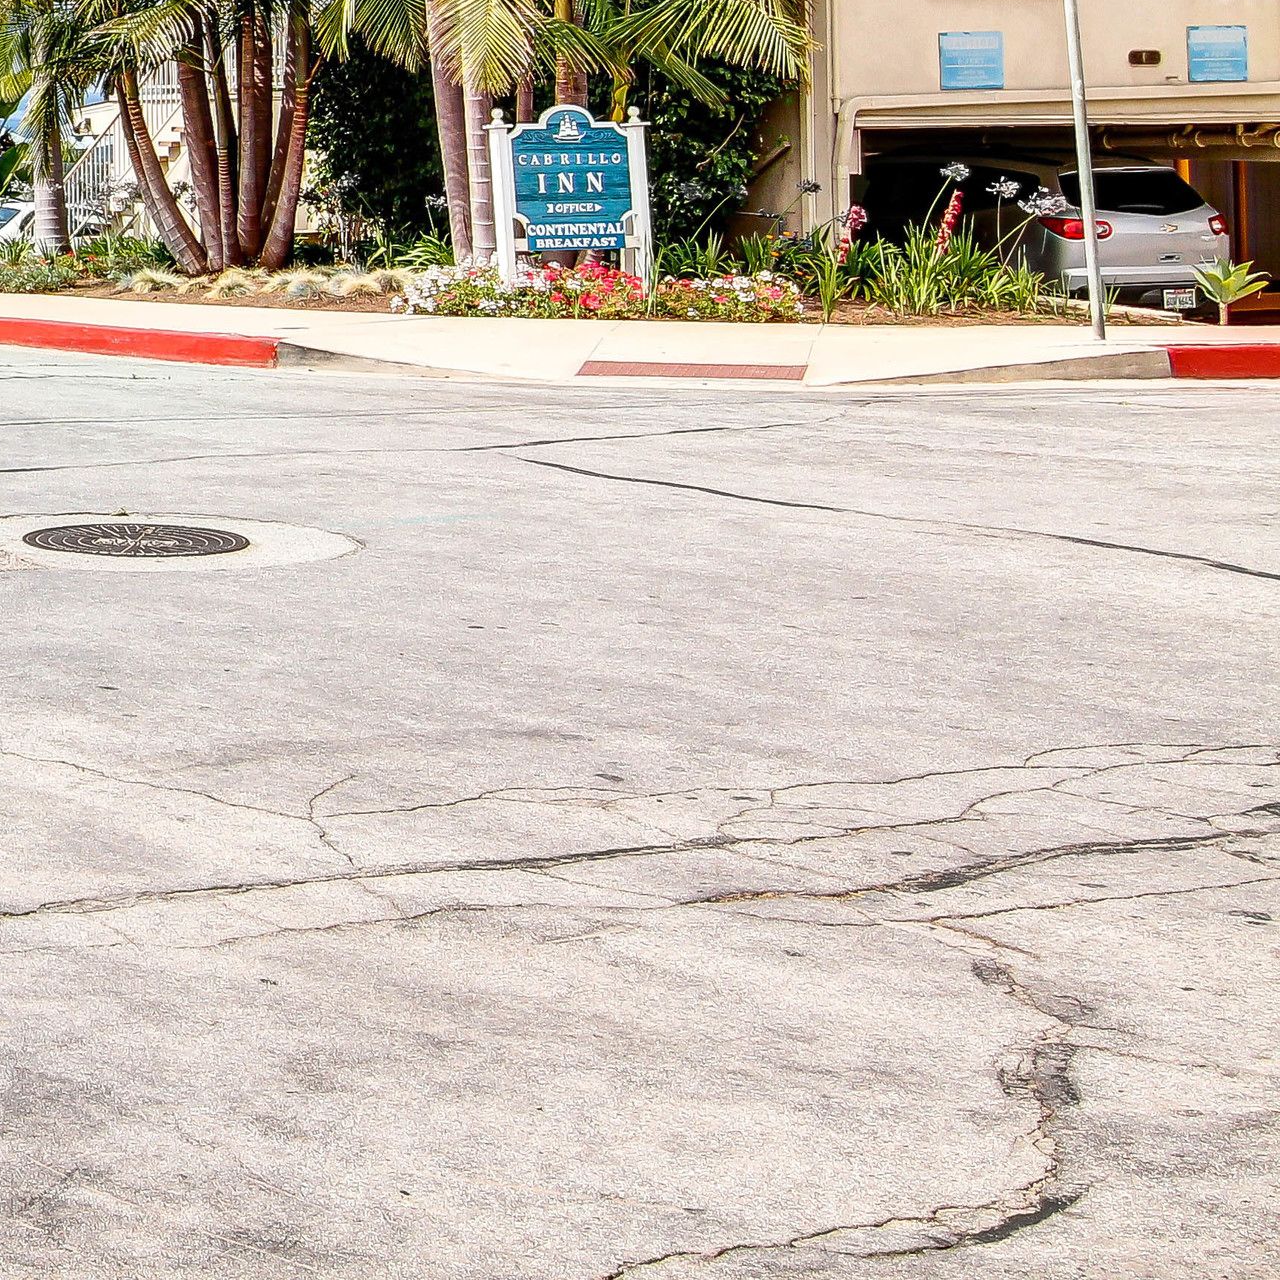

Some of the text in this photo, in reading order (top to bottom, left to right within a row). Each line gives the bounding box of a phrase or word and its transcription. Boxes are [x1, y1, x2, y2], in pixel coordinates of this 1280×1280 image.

[518, 153, 621, 165] CABRILLO
[537, 171, 604, 193] INN
[555, 203, 594, 213] OFFICE
[527, 223, 625, 236] CONTINENTAL
[535, 237, 618, 248] BREAKFAST
